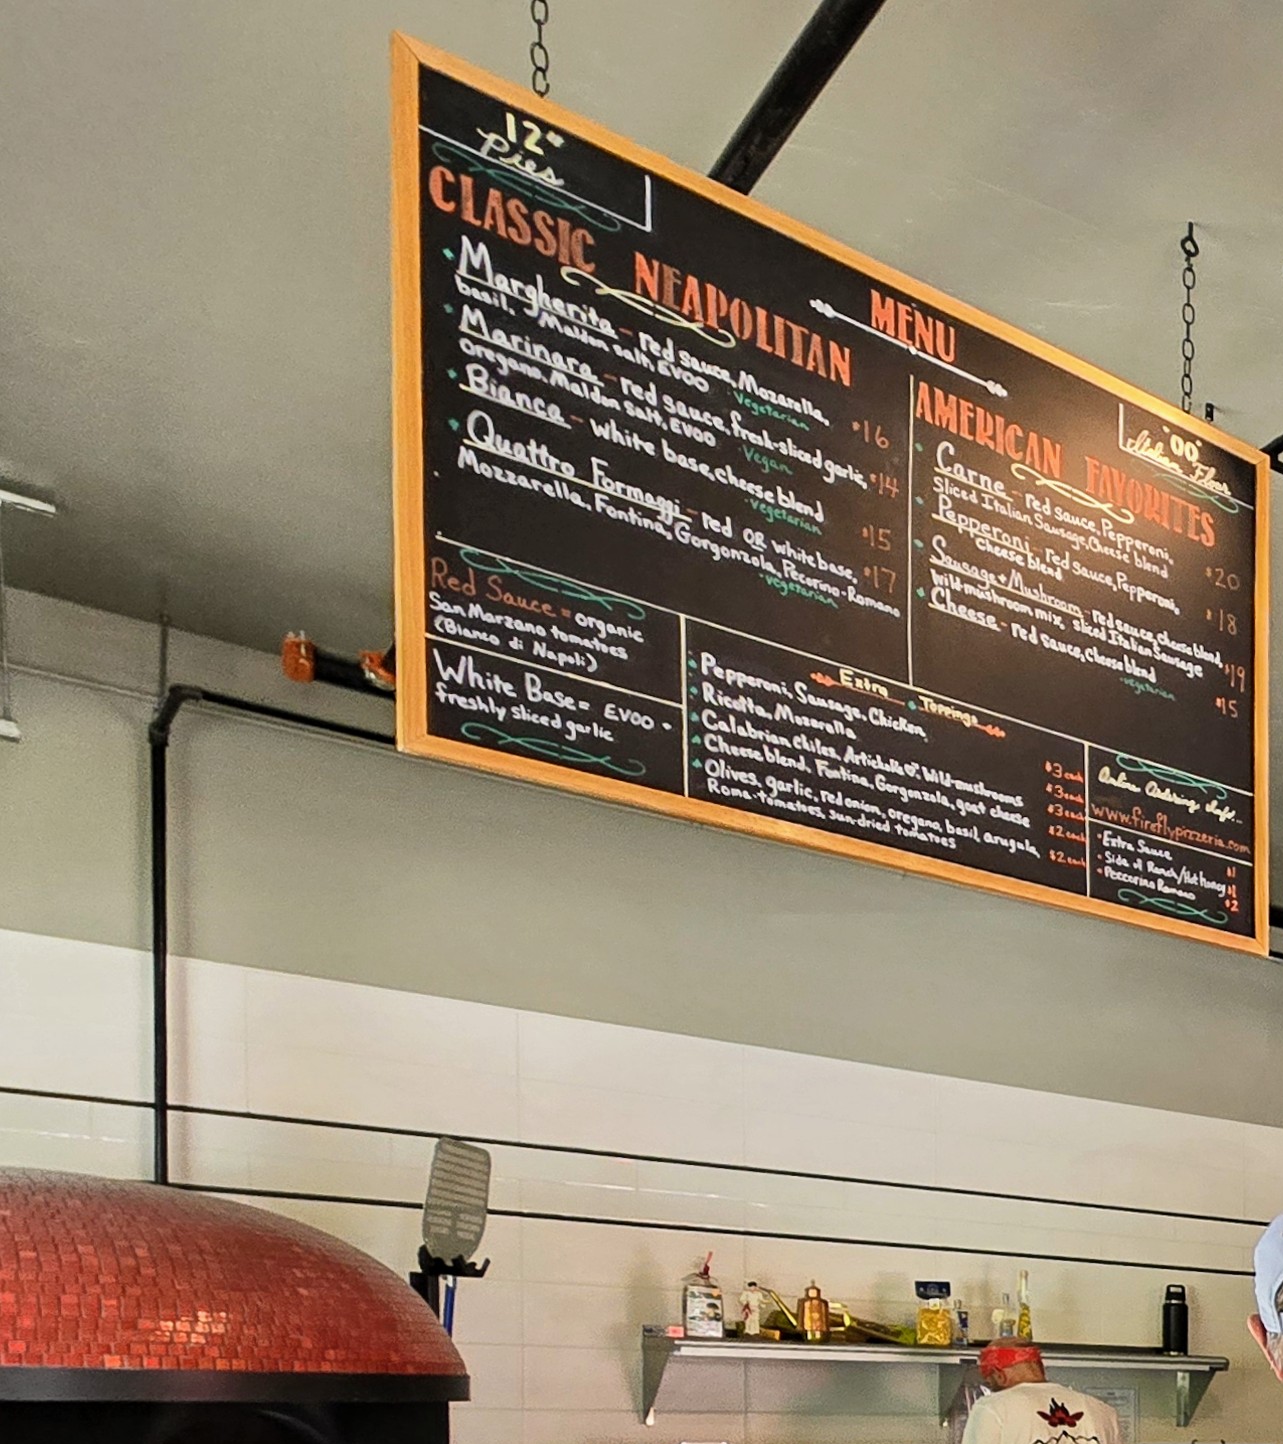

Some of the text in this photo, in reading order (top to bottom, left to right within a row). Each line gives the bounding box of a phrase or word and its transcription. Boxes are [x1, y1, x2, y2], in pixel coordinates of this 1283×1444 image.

[476, 128, 564, 190] Pies
[429, 166, 850, 385] CLASSIC NEAPOLITAN
[458, 236, 616, 348] Margherita
[638, 331, 675, 363] red
[459, 304, 598, 382] Marinara
[620, 376, 658, 406] red
[871, 290, 955, 362] MENU
[549, 369, 621, 411] Maldon
[669, 417, 716, 447] EVOO
[657, 359, 709, 393] EVOO
[465, 363, 565, 424] Bianca
[713, 464, 775, 504] cheese
[776, 485, 824, 523] blend
[916, 383, 1214, 546] AMERICAN FAVORITES
[936, 441, 1007, 497] Carne
[1025, 493, 1052, 516] red
[466, 410, 575, 479] Quattro
[590, 457, 681, 528] Formaggi
[701, 511, 733, 538] red
[742, 528, 767, 550] OR
[932, 476, 978, 504] Sliced
[981, 493, 1033, 526] Italian
[1086, 535, 1130, 563] Cheese
[1132, 550, 1168, 579] blend
[937, 493, 1031, 559] Pepperoni
[1045, 547, 1070, 570] red
[431, 556, 644, 643] Red Sauce organic
[929, 534, 996, 594] Sausage
[1006, 568, 1082, 617] Mushroom
[1091, 609, 1114, 629] red
[1027, 553, 1063, 581] blend
[428, 590, 628, 660] San Marzano tomatoes
[929, 583, 998, 628] Cheese
[1010, 622, 1038, 645] red
[433, 648, 655, 730] White EVOO
[508, 636, 524, 650] di
[532, 640, 598, 672] Napoli)
[839, 668, 888, 698] Extra
[435, 681, 614, 742] freshly sliced garlic
[701, 708, 791, 748] Calabrian
[819, 790, 843, 806] red
[955, 798, 986, 816] goat
[1091, 803, 1250, 853] www.fireflypizzeria.com
[1102, 830, 1173, 861] Extra Sauce
